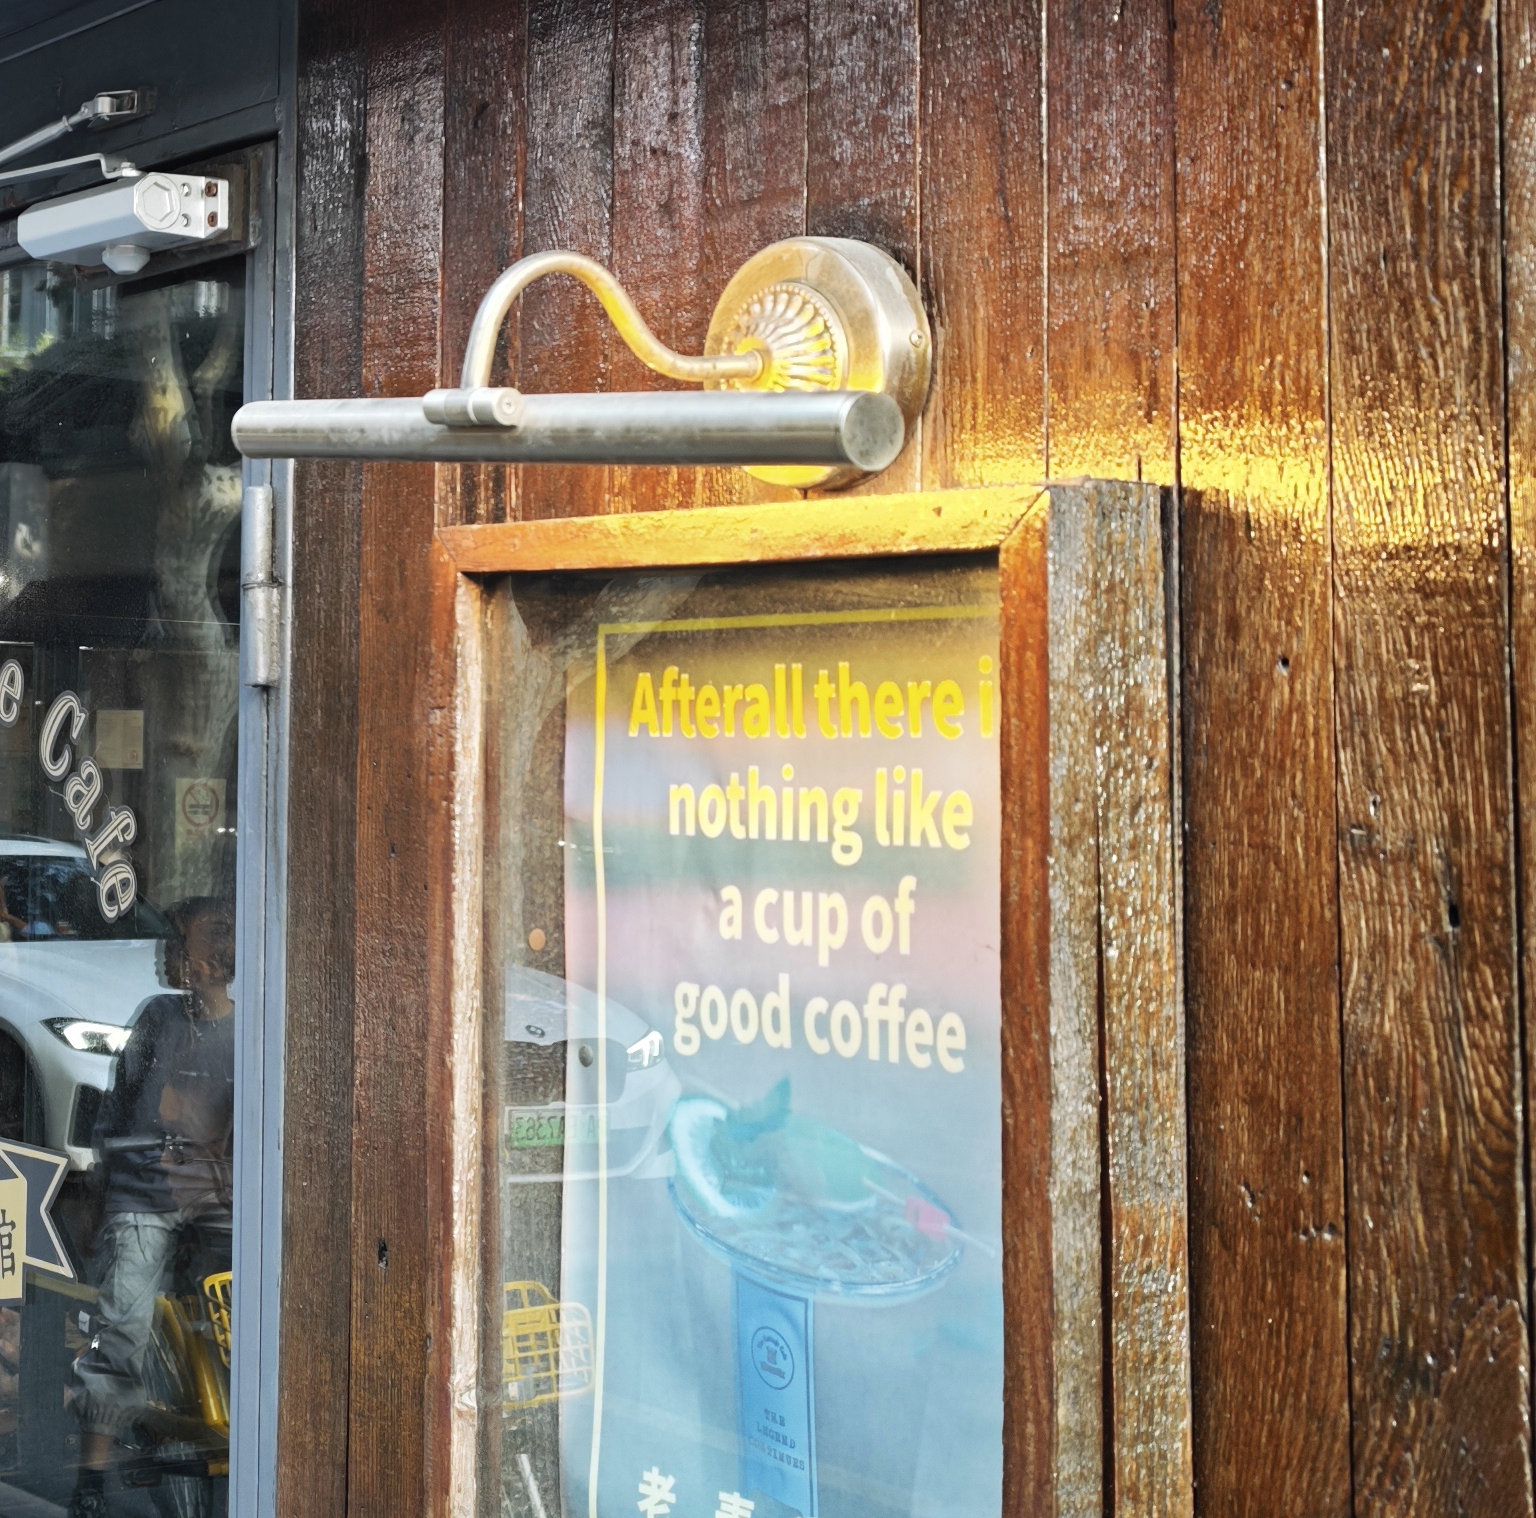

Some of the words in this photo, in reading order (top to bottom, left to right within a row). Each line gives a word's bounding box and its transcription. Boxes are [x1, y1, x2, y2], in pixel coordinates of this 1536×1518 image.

[628, 662, 808, 739] Afterall
[814, 661, 965, 740] there
[668, 764, 862, 866] nothing
[874, 765, 974, 850] like
[719, 884, 743, 940] a
[754, 886, 848, 966] cup
[861, 875, 917, 955] of
[674, 973, 792, 1057] good
[803, 982, 966, 1074] coffee
[764, 1408, 786, 1427] THE
